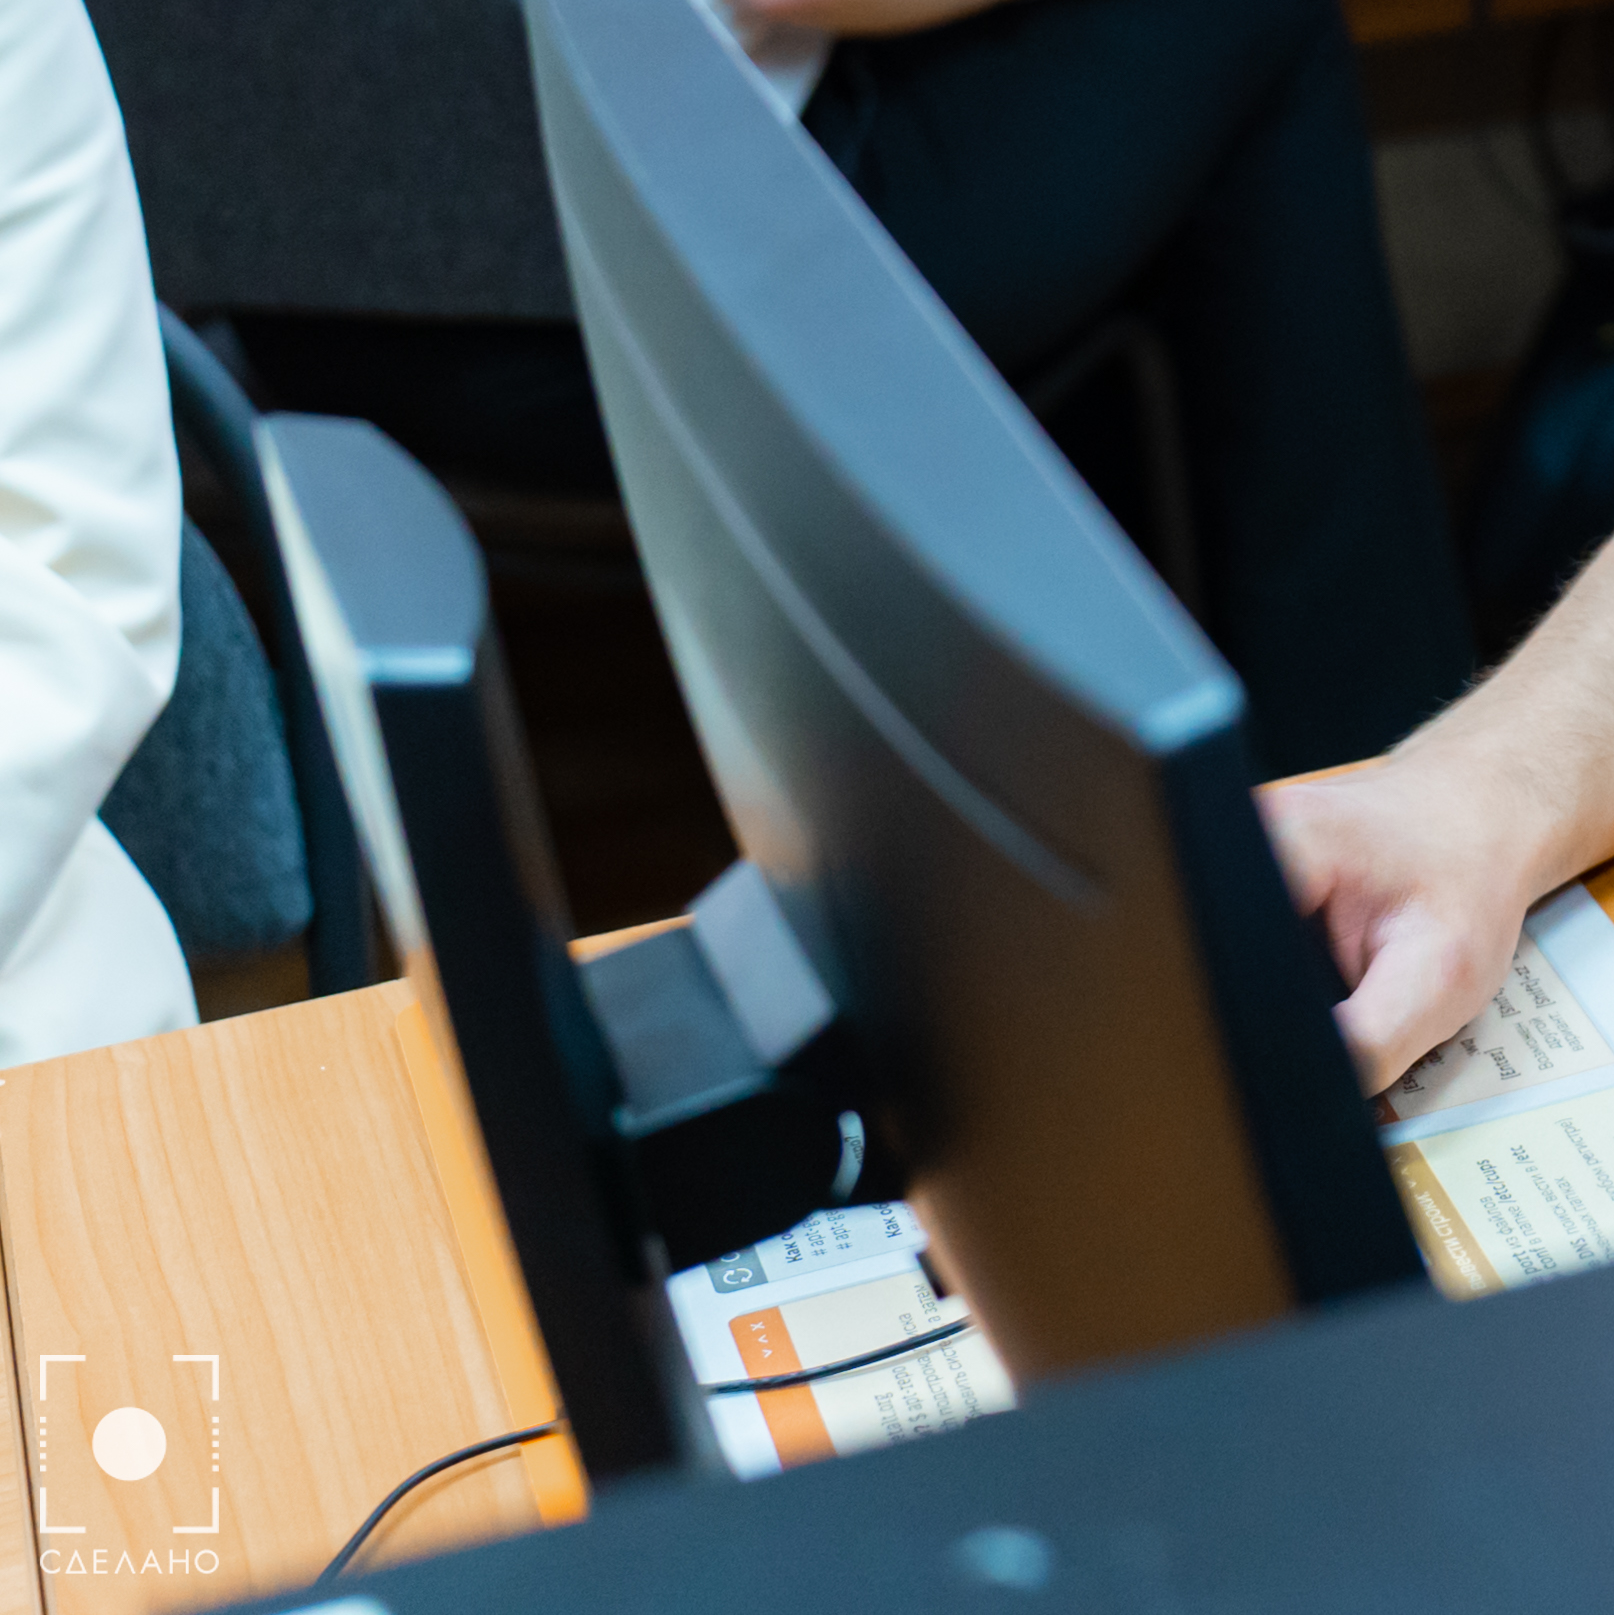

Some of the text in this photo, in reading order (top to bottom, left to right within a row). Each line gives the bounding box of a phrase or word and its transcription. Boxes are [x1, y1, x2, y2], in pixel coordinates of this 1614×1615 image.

[1512, 1021, 1554, 1072] Возможен
[1528, 1015, 1563, 1050] другой
[1482, 1046, 1521, 1081] [Enter]
[1508, 1142, 1534, 1165] /etc
[1523, 1163, 1538, 1173] в
[1474, 1157, 1517, 1206] /etc/cups
[1529, 1172, 1559, 1204] вести
[1553, 1175, 1587, 1213] папках
[881, 1215, 903, 1239] Как
[1478, 1194, 1541, 1276] port из файлов
[1506, 1203, 1536, 1238] папке
[1550, 1201, 1580, 1236] поиск
[782, 1240, 803, 1264] Как
[810, 1247, 828, 1258] #
[834, 1240, 854, 1251] #
[1526, 1236, 1542, 1247] в
[913, 1281, 938, 1315] затем
[926, 1314, 942, 1323] а
[891, 1364, 924, 1412] apt-repo
